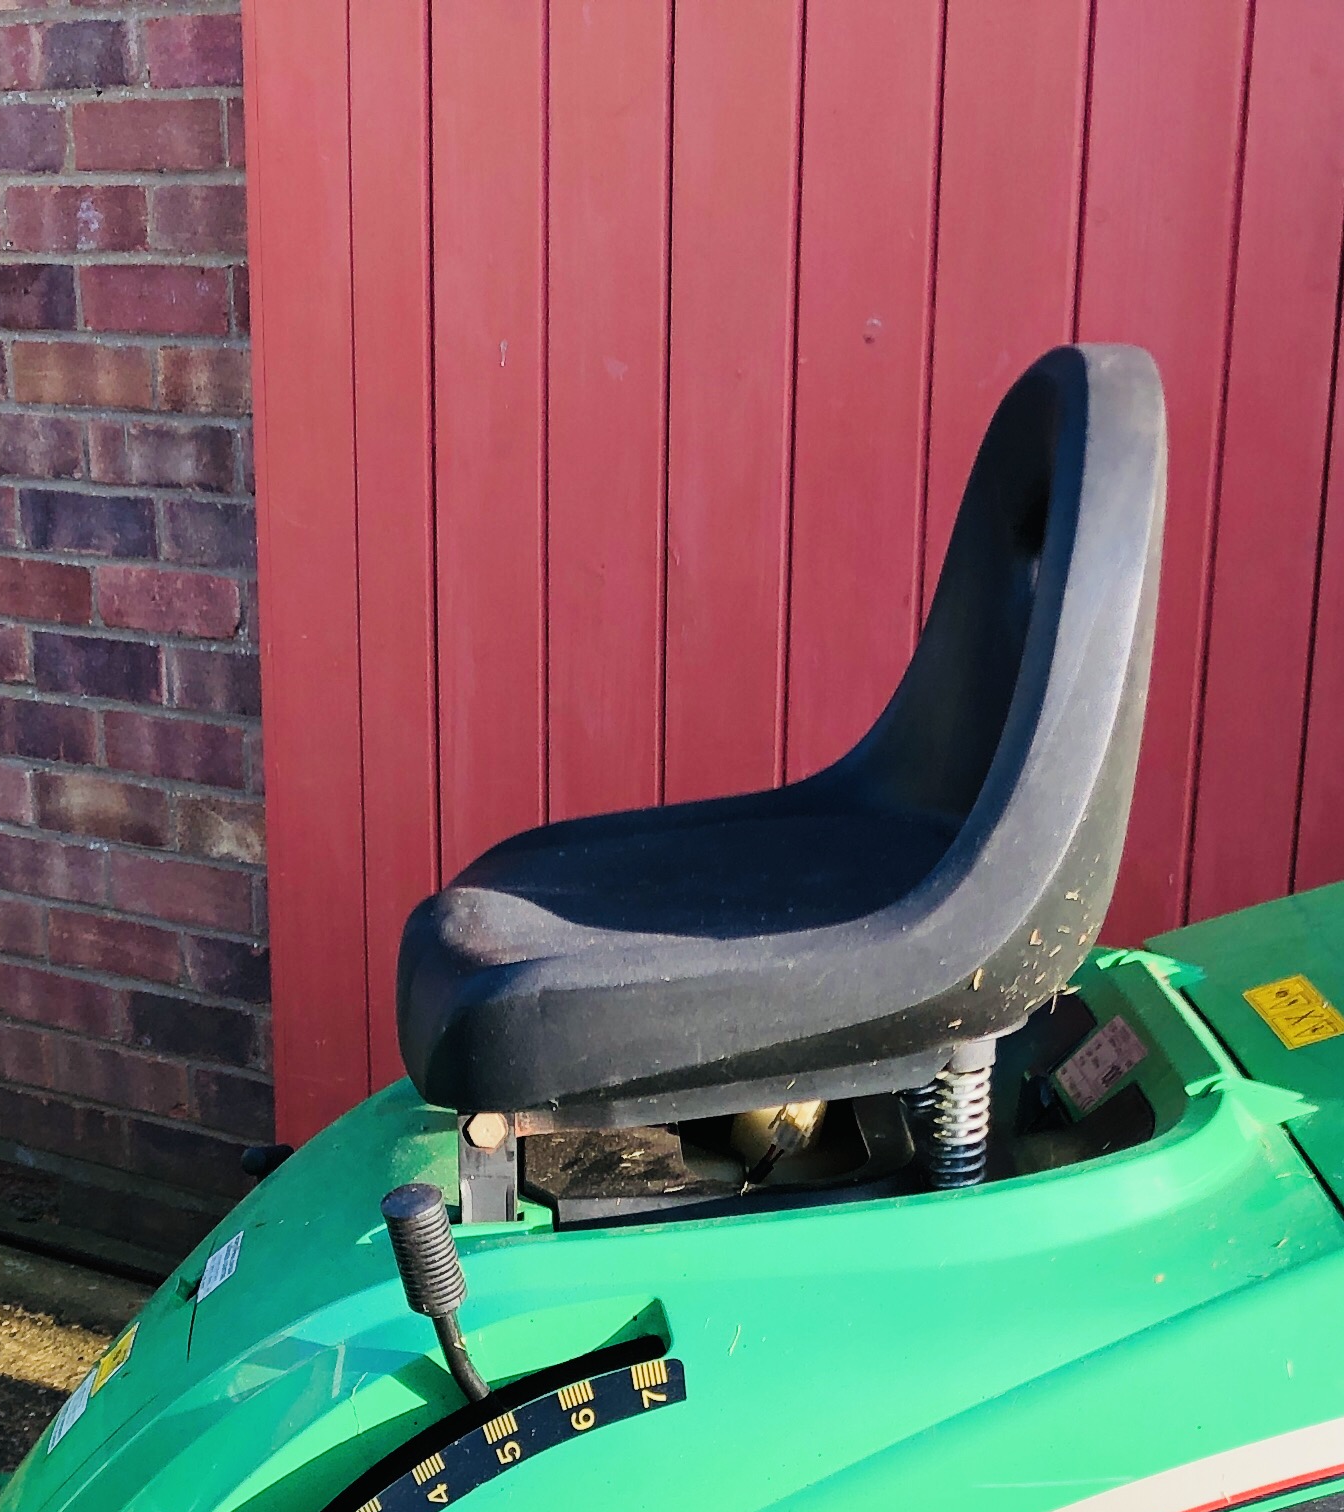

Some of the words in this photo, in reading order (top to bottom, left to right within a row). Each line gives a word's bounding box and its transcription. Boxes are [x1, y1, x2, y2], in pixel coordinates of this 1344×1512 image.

[426, 1483, 450, 1505] 4
[495, 1441, 522, 1466] 5
[570, 1408, 596, 1431] 6
[642, 1389, 668, 1409] 7
